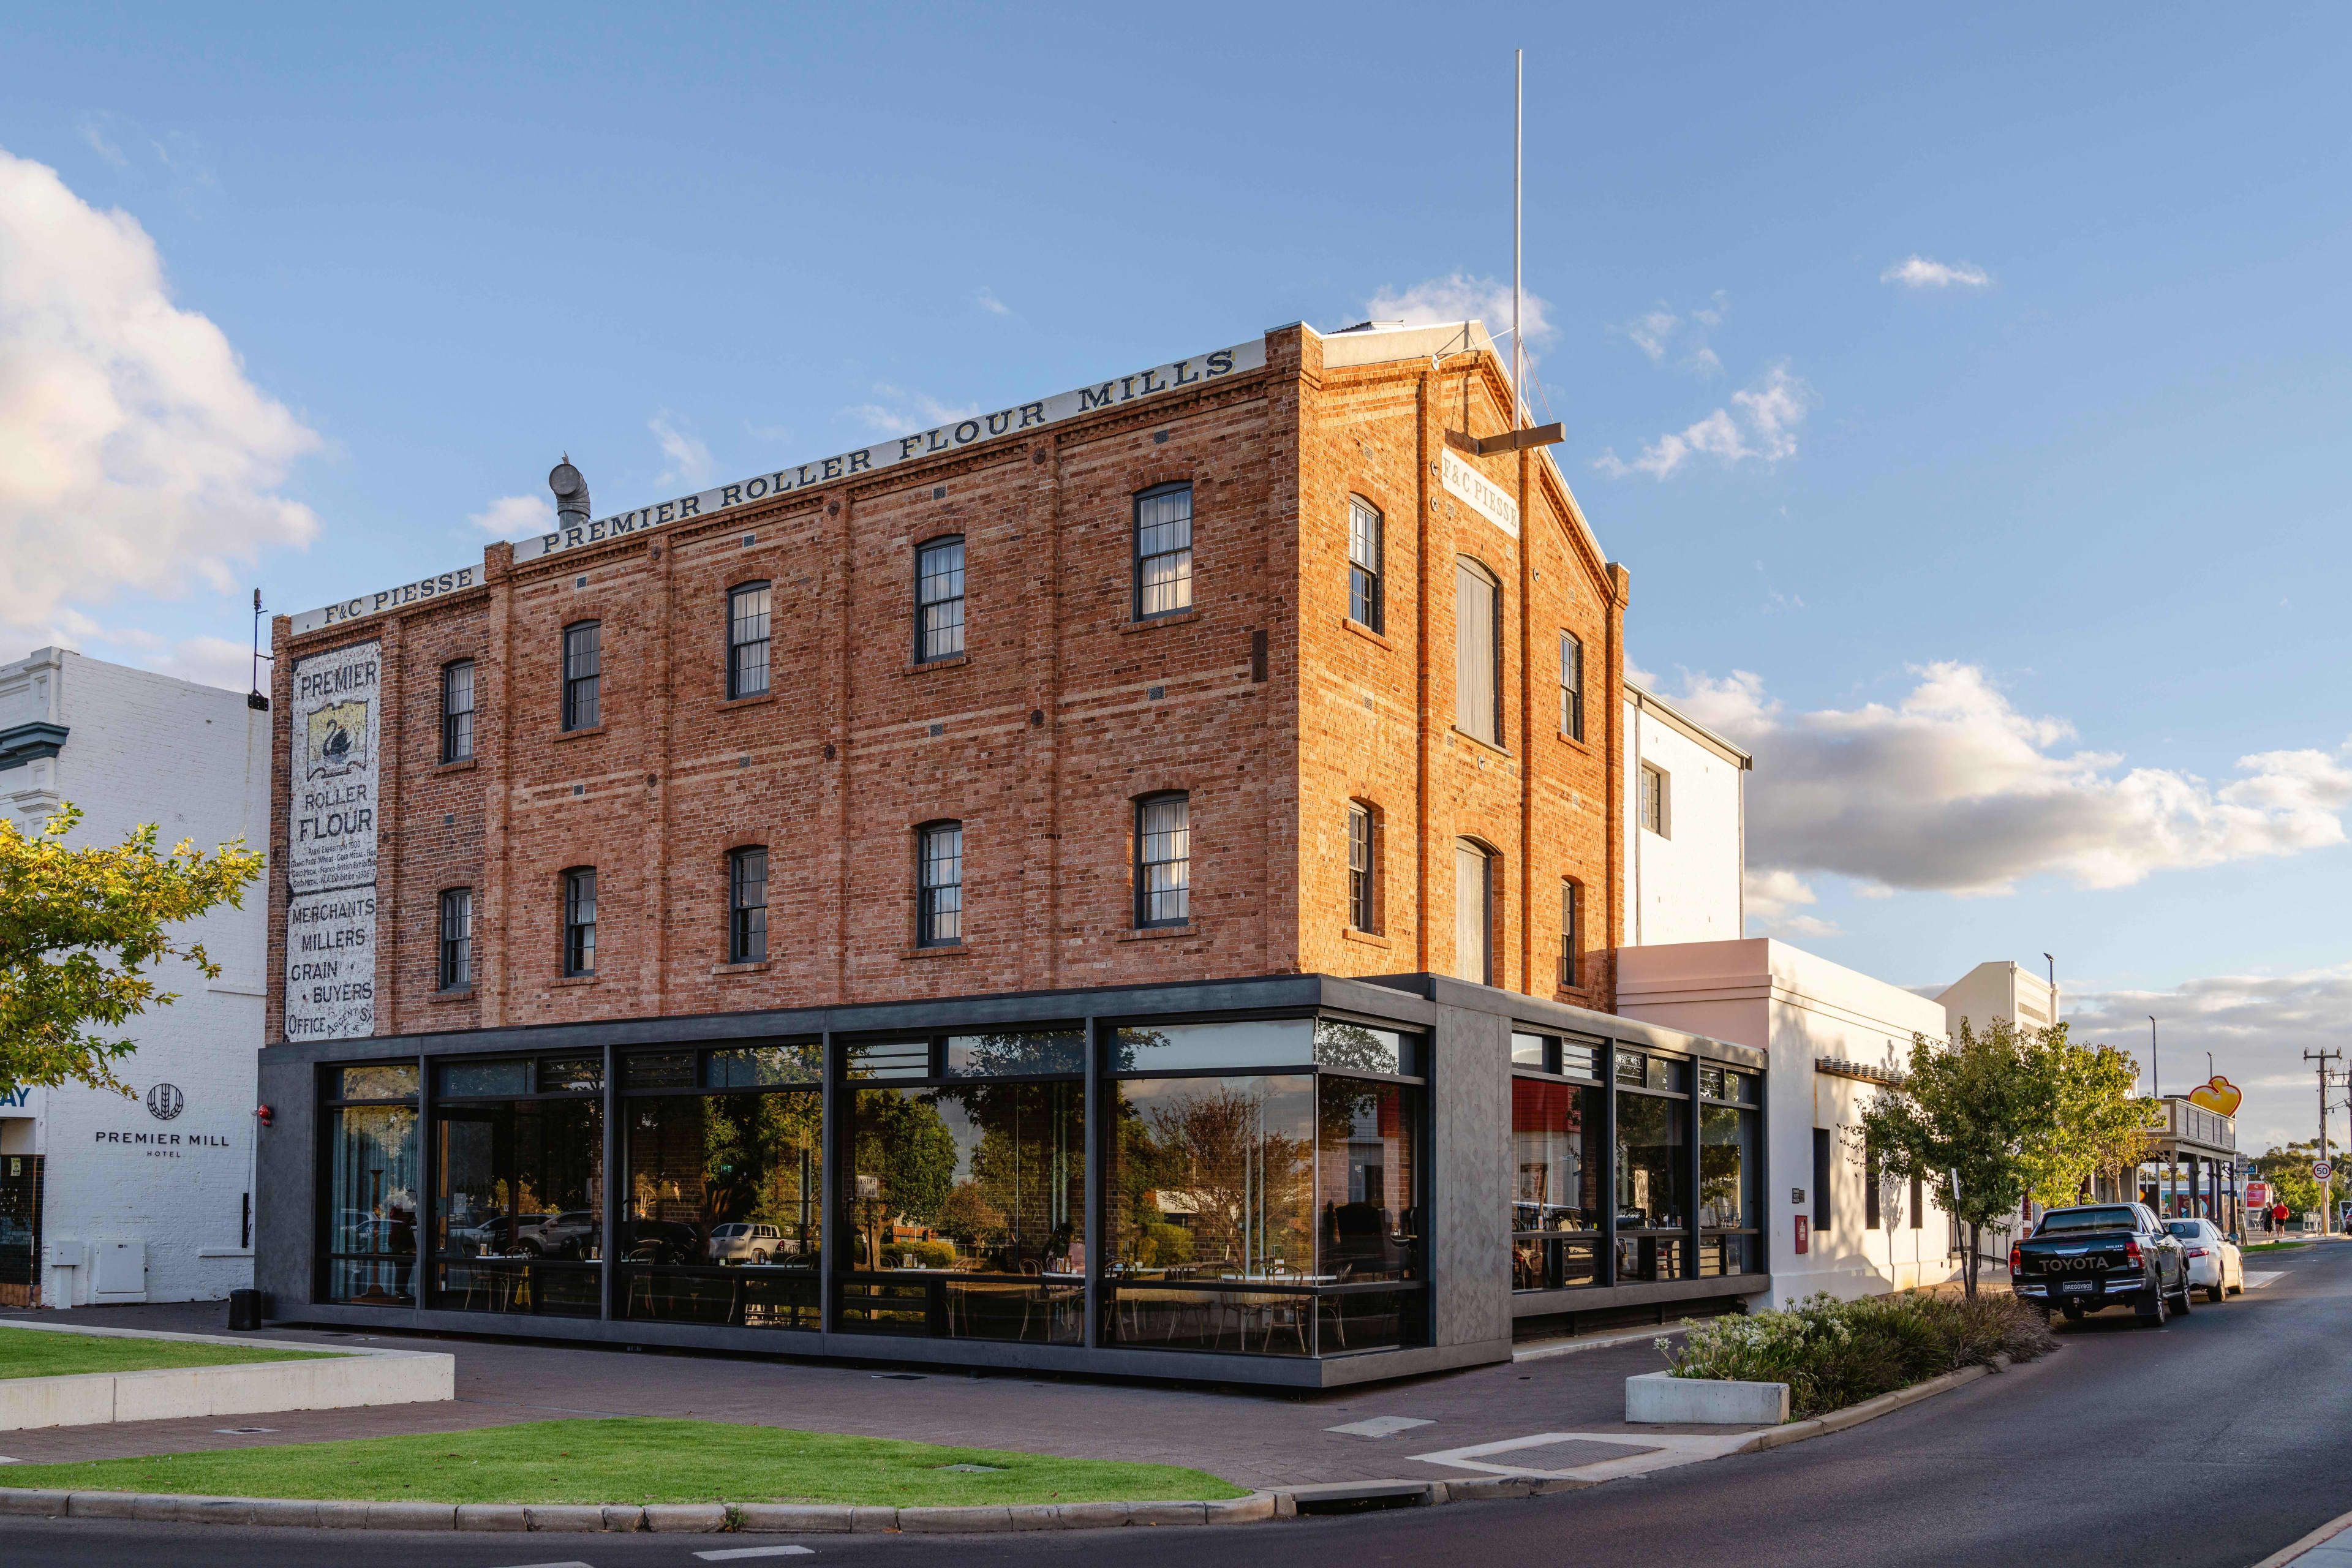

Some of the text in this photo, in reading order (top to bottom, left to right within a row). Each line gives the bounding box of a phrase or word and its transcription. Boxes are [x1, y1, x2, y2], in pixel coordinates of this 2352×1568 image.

[543, 350, 1234, 554] PREMIER ROLLER FLOUR MILLS
[1474, 479, 1517, 529] PIESSE
[373, 568, 472, 611] PIESSE
[301, 660, 377, 699] PREMIER
[305, 784, 368, 811] ROLLER
[298, 809, 372, 842] FLOUR
[308, 847, 320, 856] PARIS
[349, 840, 361, 850] 1900
[293, 880, 304, 888] GOLD
[305, 878, 318, 887] MEDAL
[331, 873, 355, 883] Exhibition
[292, 898, 376, 924] MERCHANTS
[302, 928, 366, 952] MILLERS
[291, 960, 337, 981] GRAIN
[313, 982, 372, 1004] BUYERS
[288, 1014, 326, 1035] OFFICE
[96, 1131, 230, 1147] PREMIER MILL
[2038, 1256, 2109, 1272] TOYOTA
